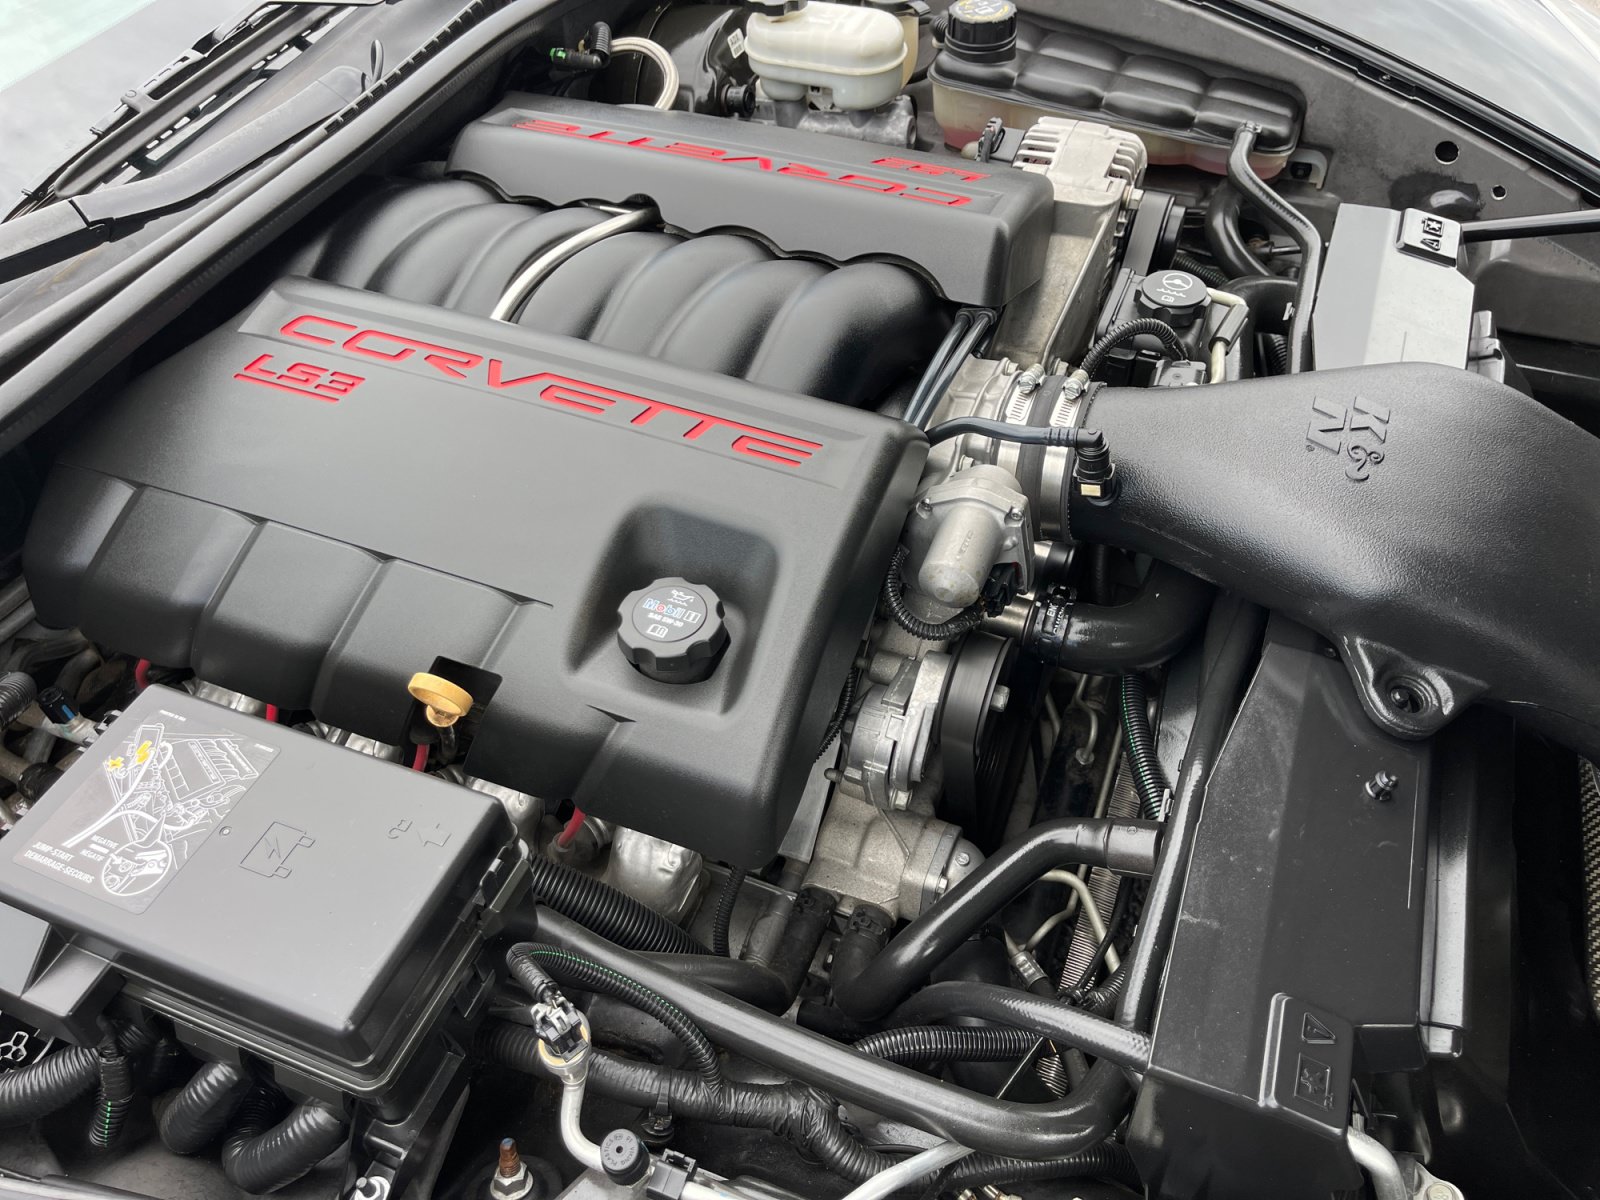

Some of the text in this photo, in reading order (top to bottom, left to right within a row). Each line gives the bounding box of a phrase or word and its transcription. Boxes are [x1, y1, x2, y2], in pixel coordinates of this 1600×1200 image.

[512, 119, 973, 206] CORVETTE
[243, 353, 366, 394] LS3
[280, 315, 822, 467] CORVETTE
[643, 598, 686, 619] Mobil
[24, 850, 95, 884] DEMARRAGE-SECOURS
[32, 841, 75, 861] JUMP-START
